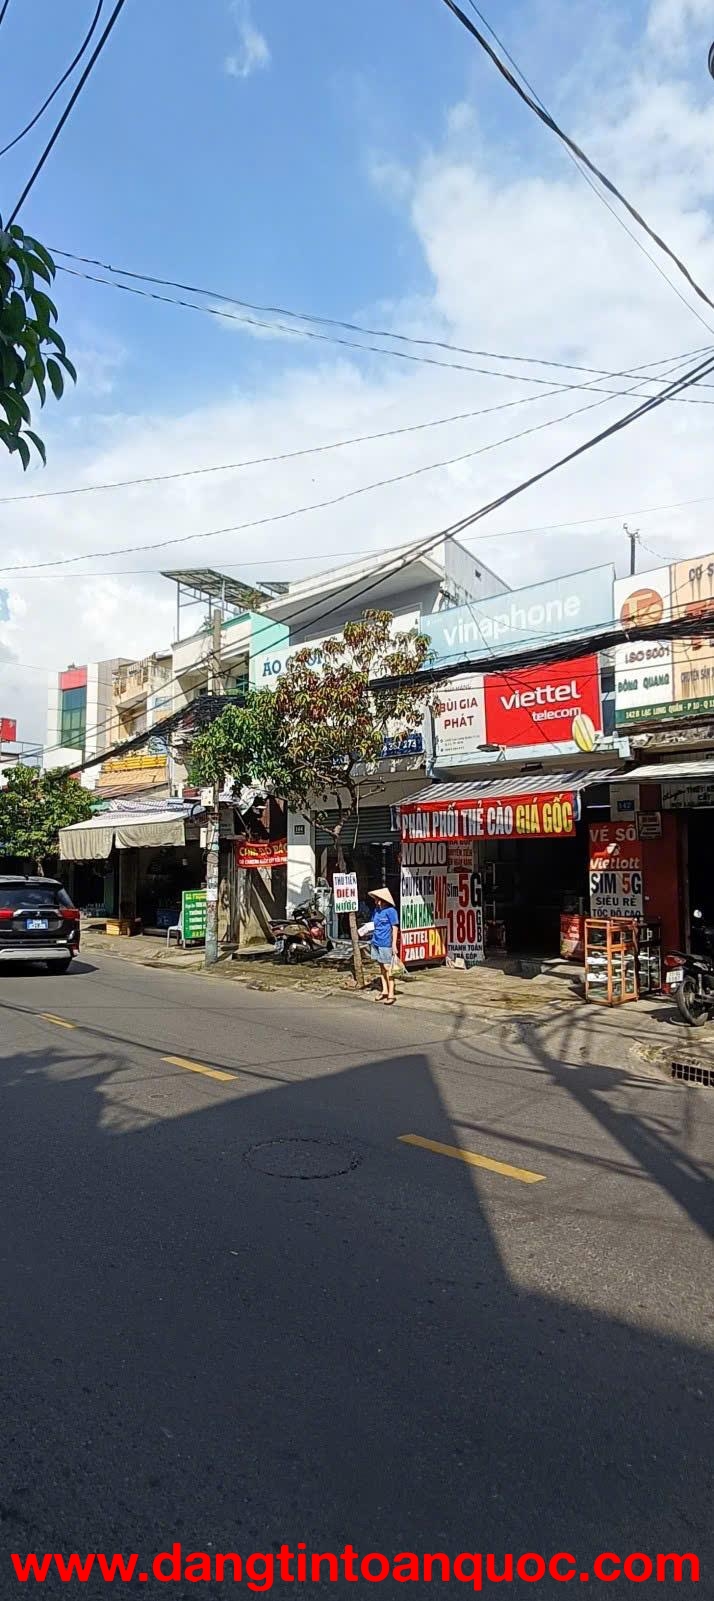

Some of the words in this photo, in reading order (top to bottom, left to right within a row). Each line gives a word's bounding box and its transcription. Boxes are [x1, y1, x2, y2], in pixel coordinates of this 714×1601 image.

[443, 594, 581, 646] vinaphone
[262, 656, 282, 677] ÁO
[643, 673, 671, 690] QUANG
[459, 697, 479, 712] GIA
[500, 680, 582, 710] viettel
[443, 714, 475, 731] PHÁT
[532, 706, 582, 722] telecom
[432, 801, 459, 838] PHỐI
[460, 799, 485, 836] THẺ
[486, 800, 514, 836] CÀO
[515, 796, 541, 834] GIÁ
[542, 793, 573, 834] GỐC
[401, 842, 447, 865] MOMO
[589, 856, 641, 870] Vietlott
[459, 874, 482, 908] 5G
[590, 872, 617, 894] SIM
[622, 872, 642, 894] 5G
[446, 910, 476, 944] 180
[402, 930, 428, 946] VIETTEL
[404, 946, 427, 962] ZALO
